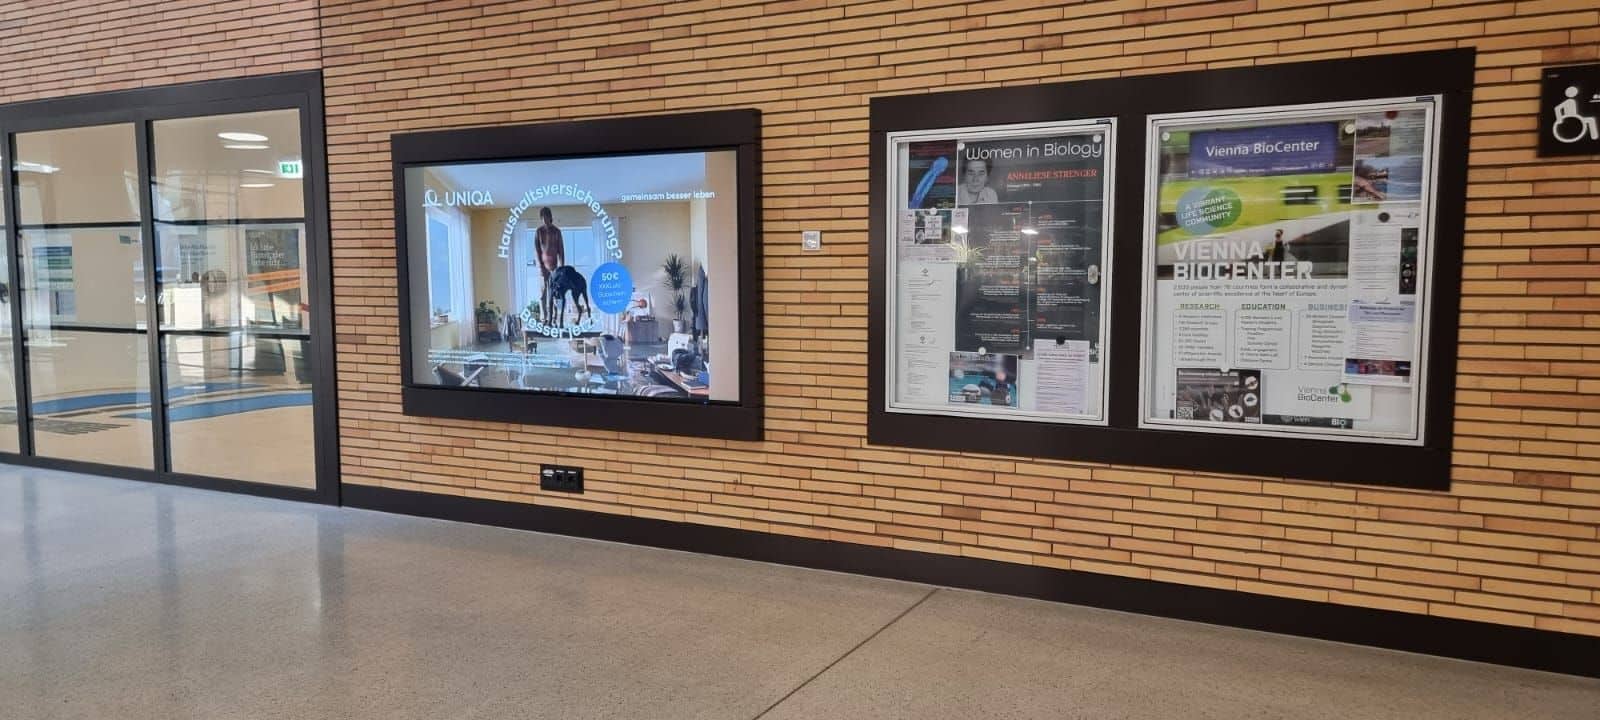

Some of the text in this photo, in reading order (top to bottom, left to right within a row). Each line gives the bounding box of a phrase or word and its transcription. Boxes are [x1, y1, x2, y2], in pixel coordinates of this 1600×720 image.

[966, 147, 1022, 160] Women
[1026, 144, 1039, 158] in
[1044, 141, 1102, 158] Biology
[1206, 141, 1320, 157] Vienna BioCenter
[1051, 168, 1097, 179] STRENGER
[445, 189, 494, 206] UNIQA
[621, 190, 715, 202] gemeinsam besser leben
[498, 183, 623, 259] Haushaltsversicherung?
[1185, 211, 1232, 225] COMMUNITY
[1174, 240, 1265, 260] VIENNA
[1174, 261, 1314, 280] BIOCENTER
[520, 308, 568, 338] Besser
